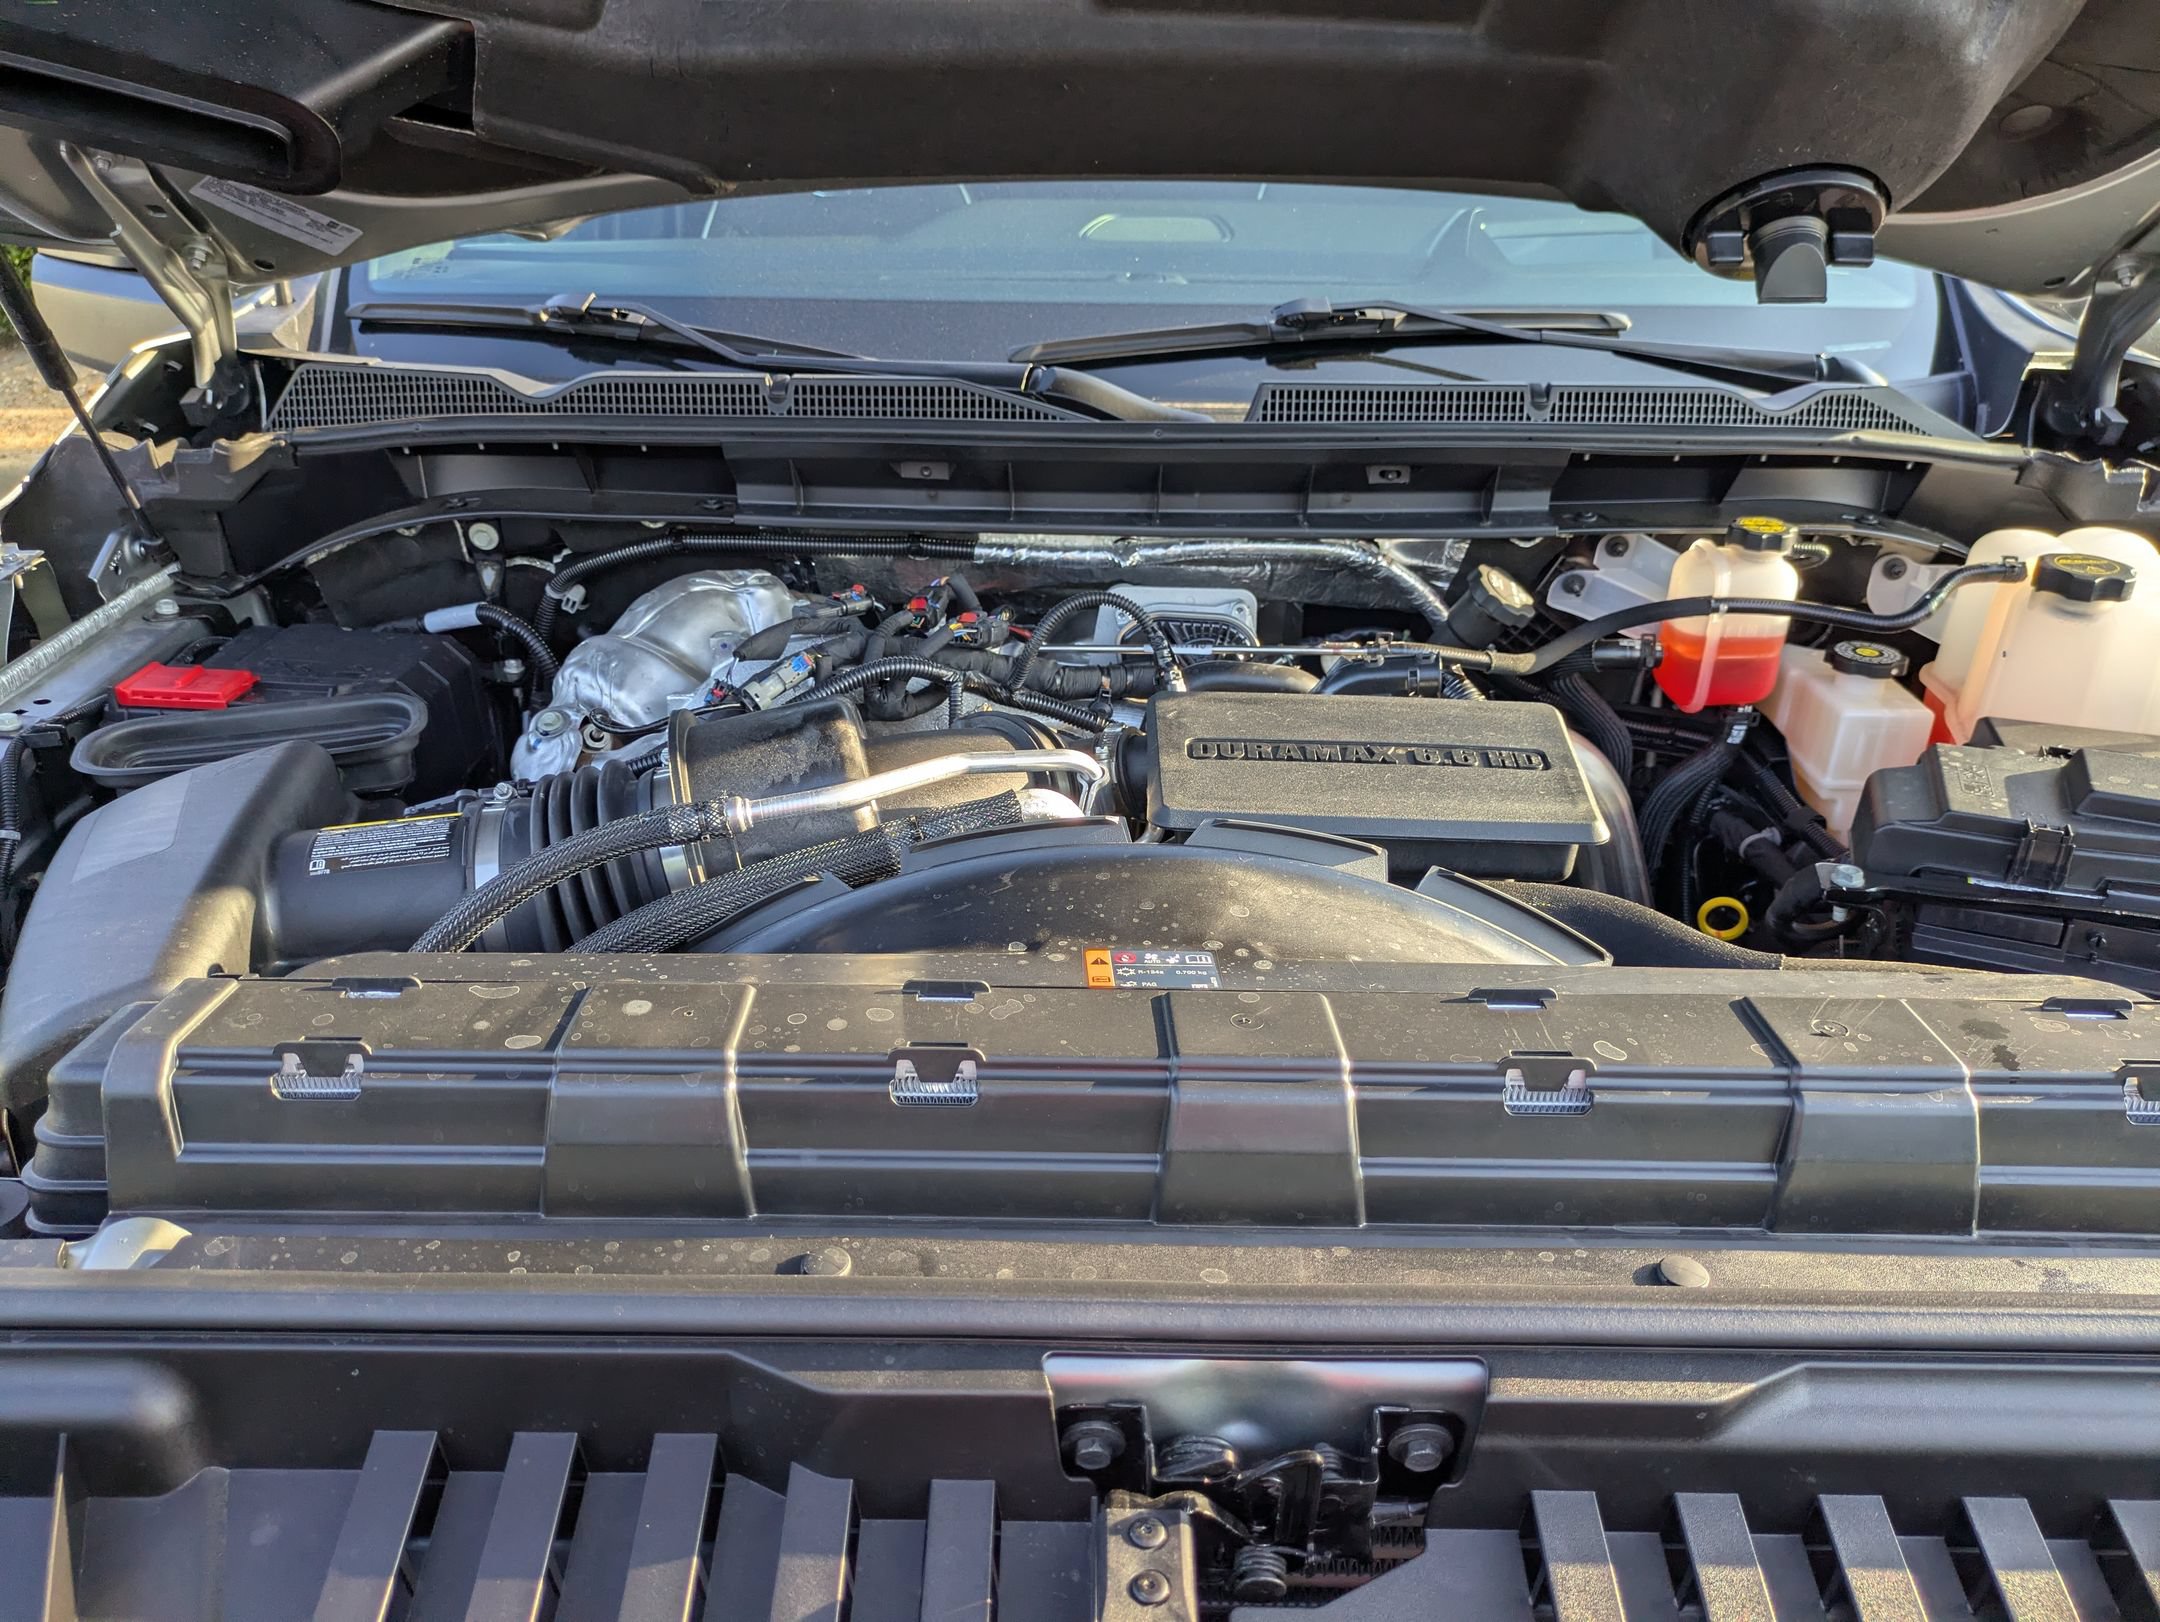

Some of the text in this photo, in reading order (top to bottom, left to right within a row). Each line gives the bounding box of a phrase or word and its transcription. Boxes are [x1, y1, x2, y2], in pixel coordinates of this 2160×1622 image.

[1192, 741, 1543, 769] DURAMAX 6.6 HD
